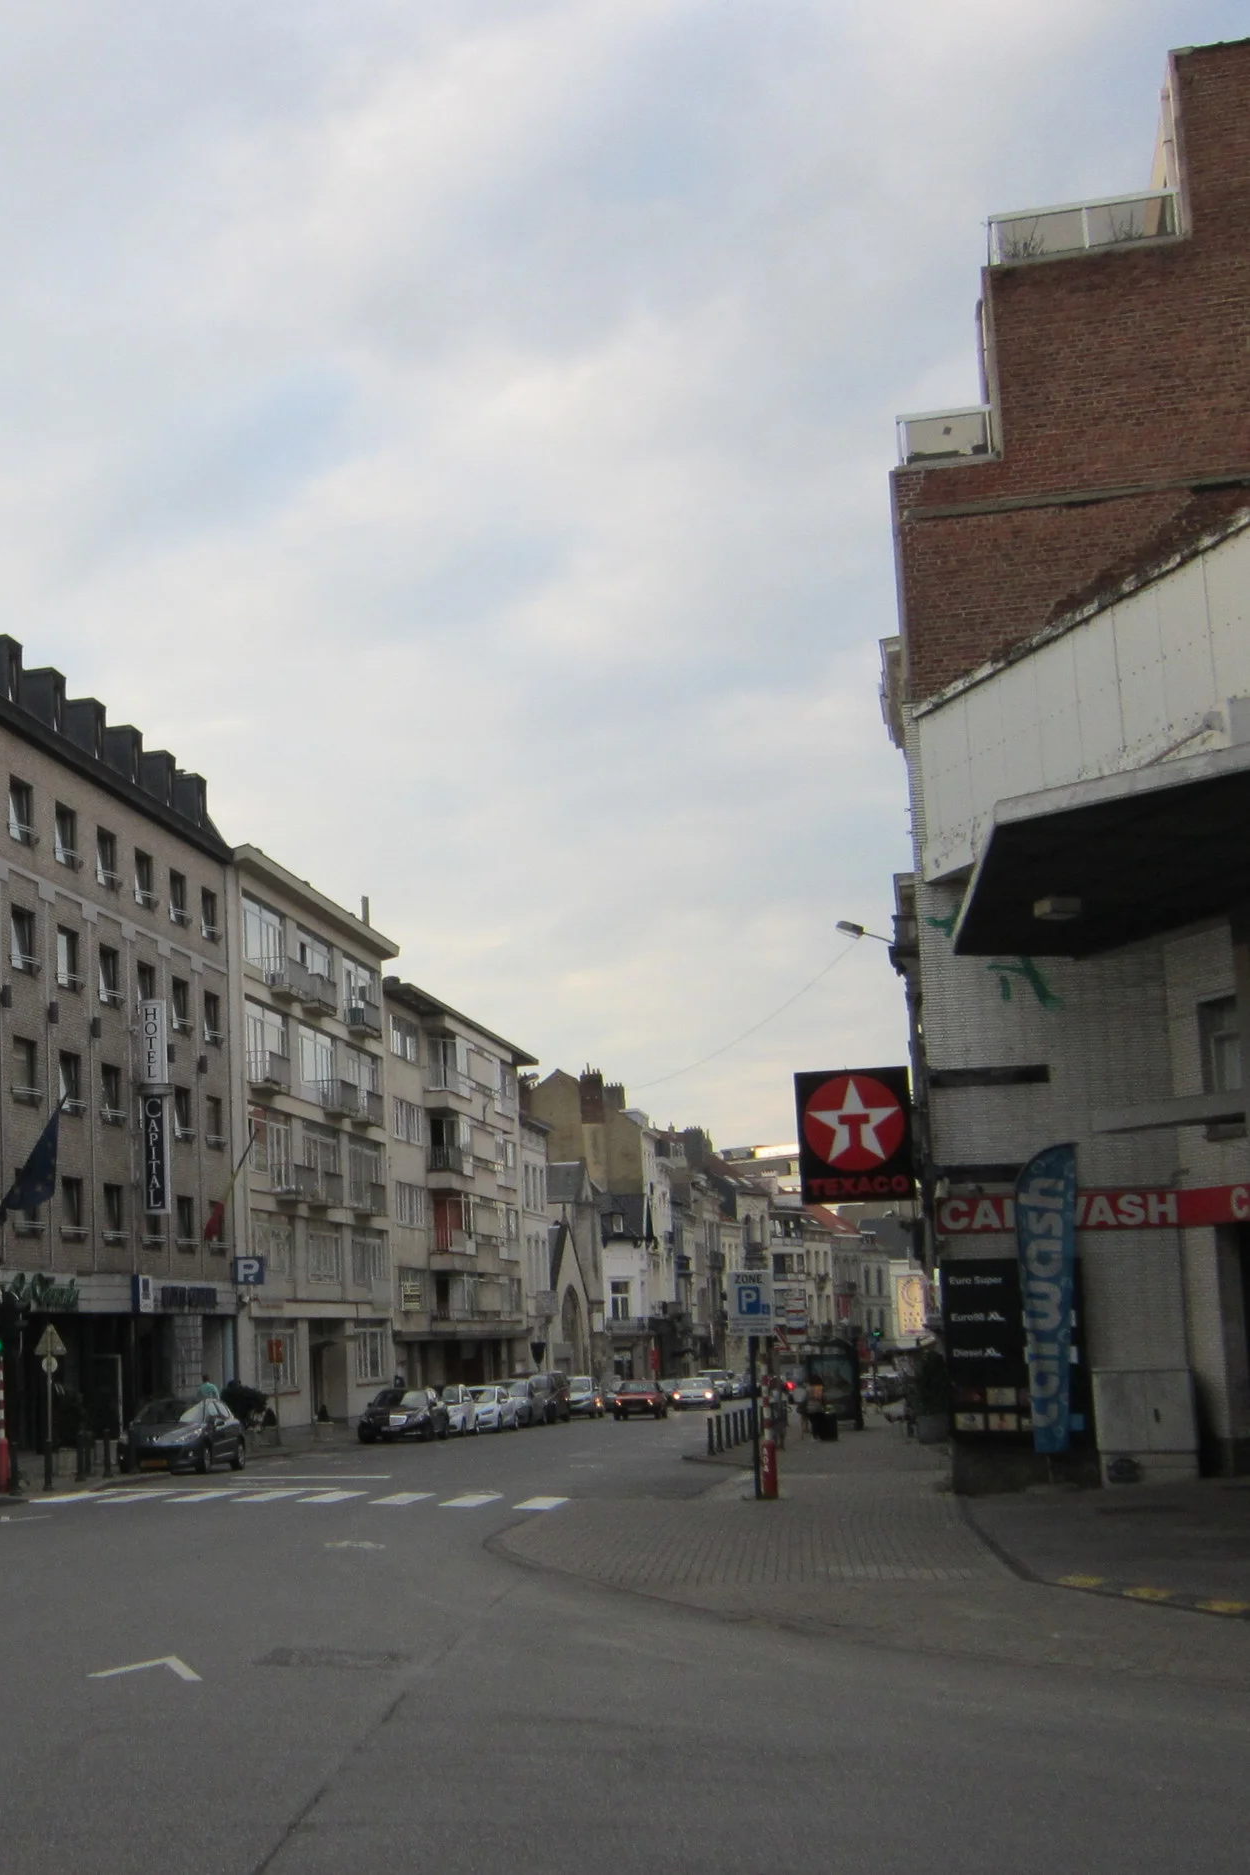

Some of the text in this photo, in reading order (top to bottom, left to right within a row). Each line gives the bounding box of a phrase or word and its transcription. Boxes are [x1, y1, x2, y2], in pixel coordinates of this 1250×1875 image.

[144, 1007, 158, 1078] HOTEL
[143, 1098, 163, 1209] CAPITAL
[809, 1175, 909, 1196] TEXACO
[1076, 1193, 1178, 1227] ASH
[734, 1273, 763, 1284] ZONE
[949, 1275, 1003, 1286] Euro Super
[1019, 1177, 1064, 1428] carwash
[953, 1348, 982, 1358] Diesel
